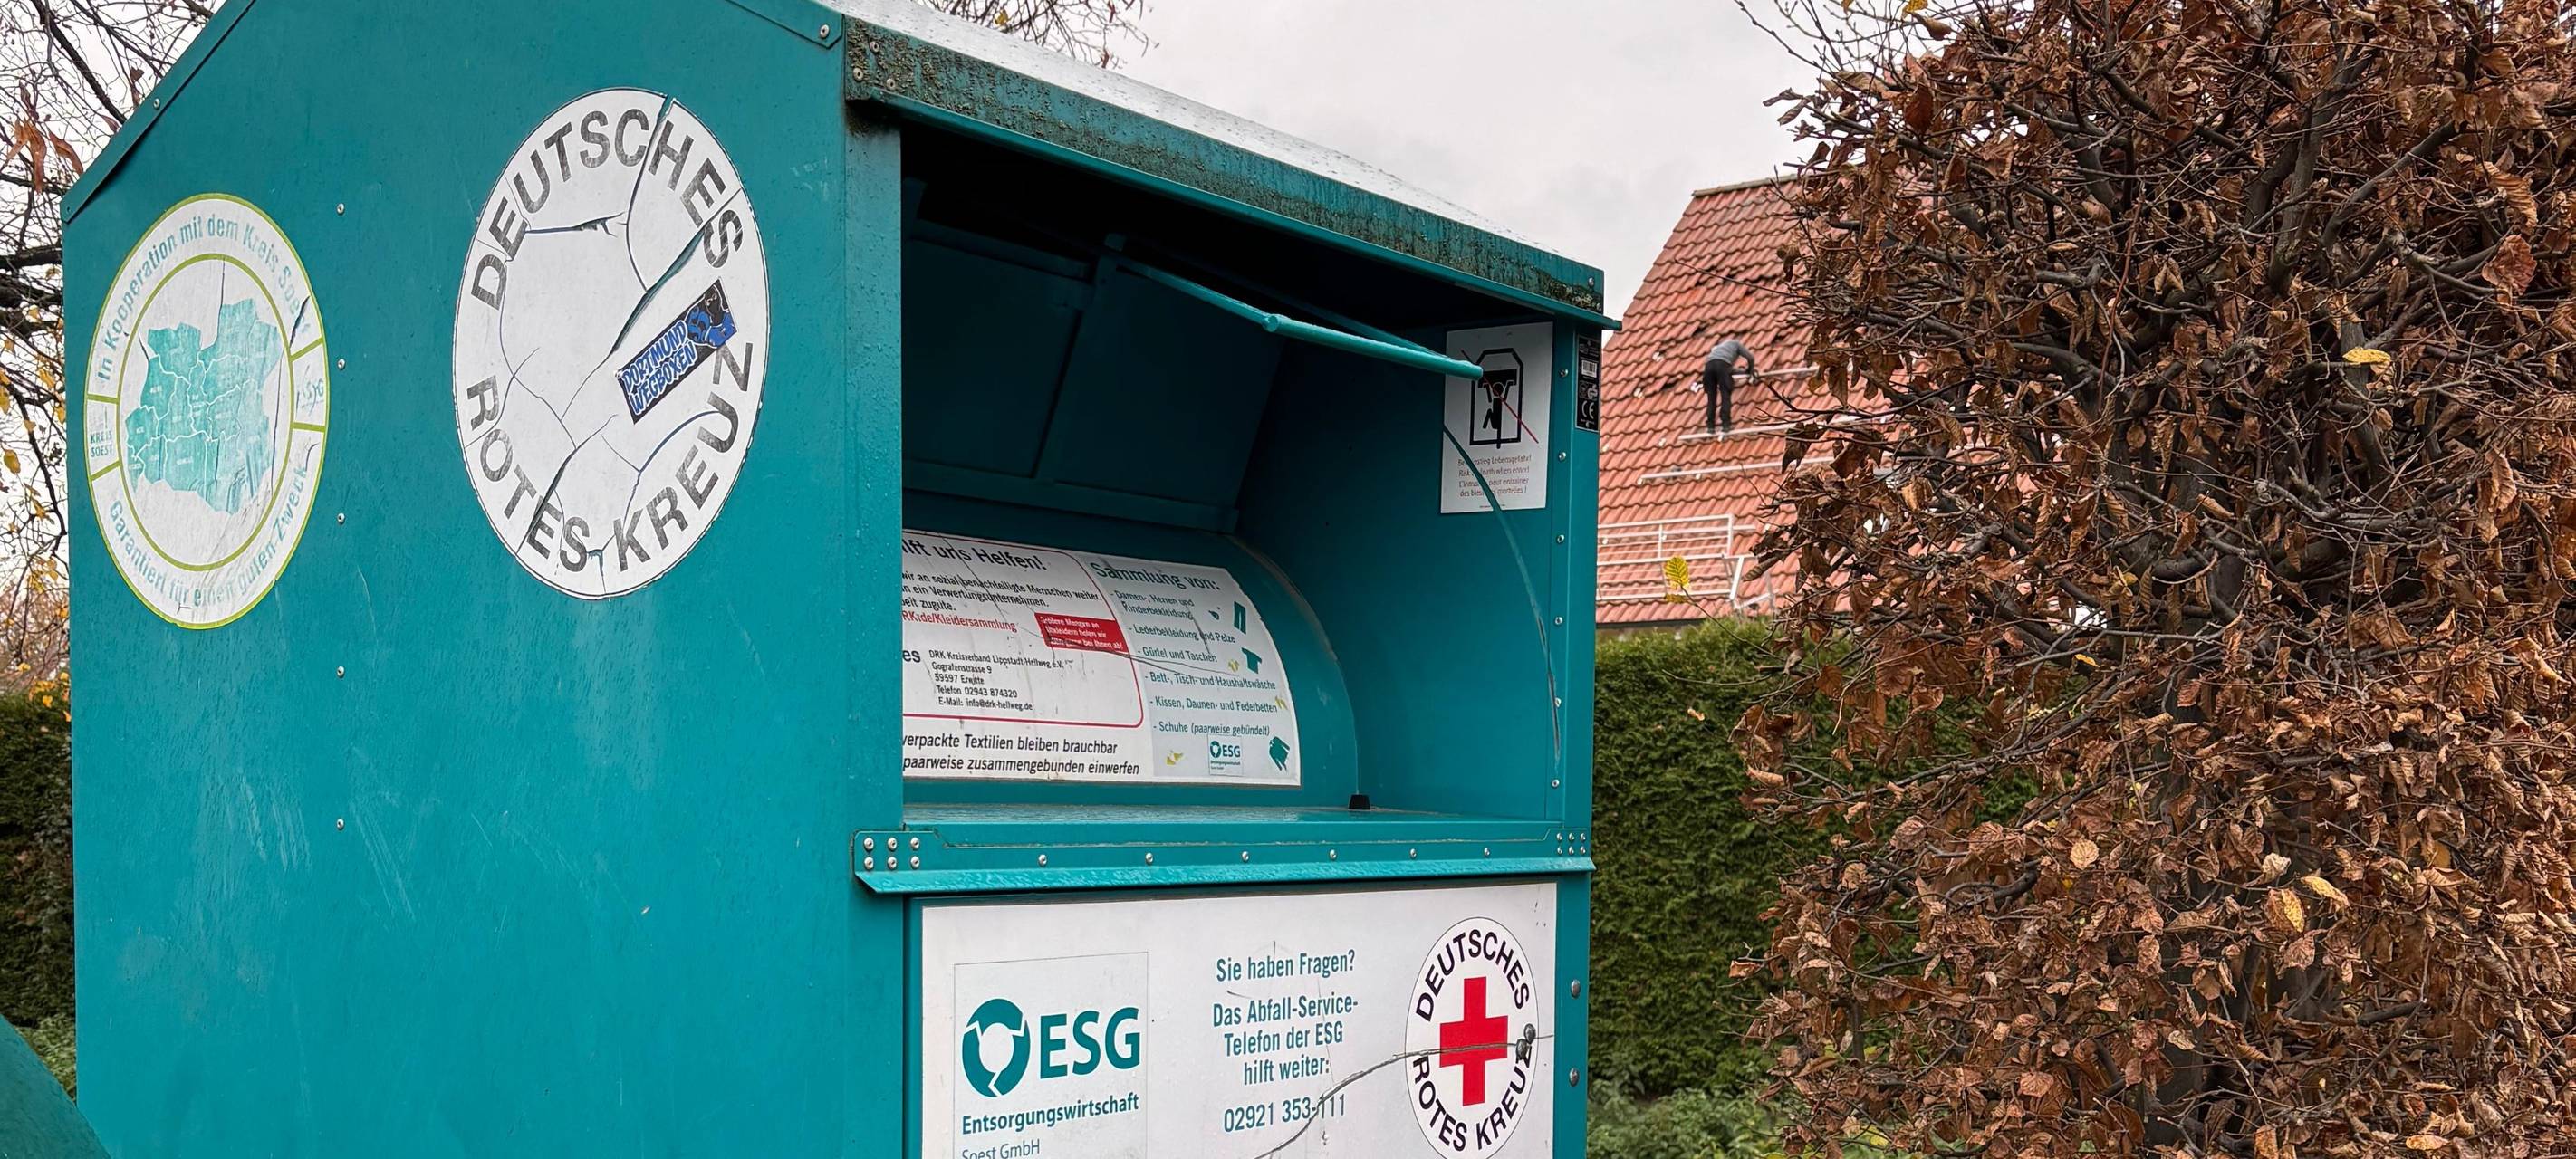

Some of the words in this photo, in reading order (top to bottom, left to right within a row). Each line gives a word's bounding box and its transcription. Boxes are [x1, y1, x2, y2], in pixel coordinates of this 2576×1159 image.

[471, 108, 744, 311] DEUTSCHES
[180, 215, 204, 244] mit
[207, 213, 238, 241] dem
[243, 223, 279, 273] Kreis
[103, 233, 178, 351] Kooperation
[278, 265, 312, 335] Soet
[97, 358, 113, 381] In
[622, 320, 688, 394] DORTMUND
[629, 341, 698, 415] WEGBOXEN
[91, 430, 112, 444] KREIS
[91, 444, 112, 458] SOEST
[466, 374, 591, 573] ROTES
[612, 340, 754, 572] KREUZ
[110, 500, 167, 593] Garantiert
[169, 576, 189, 605] für
[237, 541, 277, 596] guten
[273, 466, 308, 542] Zweck
[933, 545, 972, 561] uns
[971, 547, 1047, 570] Helfen!
[917, 573, 930, 583] an
[931, 574, 959, 586] sozial
[1026, 583, 1072, 599] Menschen
[1090, 562, 1187, 589] Sammlung
[1184, 576, 1221, 590] von:
[913, 584, 929, 595] ein
[920, 599, 957, 612] zugute.
[1178, 597, 1196, 608] und
[1132, 623, 1200, 641] Lederbekleidung
[1216, 632, 1236, 644] Pelze
[928, 649, 946, 659] DRK
[947, 650, 991, 663] Kreisverband
[992, 655, 1051, 669] Lippstadt-Hellweg
[1142, 646, 1168, 659] Gürtel
[1170, 649, 1185, 660] und
[1185, 650, 1217, 663] Taschen
[935, 673, 958, 684] 59597
[986, 665, 992, 674] 9
[1149, 671, 1174, 685] Bett-,
[1174, 673, 1198, 685] Tisch-
[1198, 676, 1215, 686] und
[1216, 676, 1276, 690] Haushaltswäsche
[937, 685, 962, 695] Telefon
[964, 686, 988, 696] 02943
[990, 688, 1018, 698] 874320
[938, 696, 964, 707] E-Mail:
[966, 698, 1033, 711] info@drk-hellweg.de
[1155, 695, 1185, 710] Kissen,
[1186, 697, 1218, 710] Daunen-
[1219, 700, 1235, 711] und
[1235, 700, 1278, 714] Federbetten
[1158, 721, 1188, 733] Schuhe
[1191, 723, 1231, 735] (paarweise
[1232, 724, 1271, 738] gebündelt)
[965, 734, 1014, 751] Textilien
[1017, 736, 1059, 752] bleiben
[1062, 738, 1118, 755] brauchbar
[1222, 743, 1241, 759] ESG
[903, 755, 964, 771] paarweise
[967, 758, 1085, 775] zusammengebunden
[1088, 760, 1140, 776] einwerfen
[1216, 957, 1241, 982] Sie
[1247, 954, 1293, 980] haben
[1299, 949, 1355, 979] Fragen?
[1416, 929, 1530, 1021] DEUTSCHES
[1213, 1002, 1241, 1027] Das
[1246, 991, 1359, 1023] Abfall-Service-
[1040, 1006, 1140, 1079] ESG
[1224, 1029, 1280, 1057] Telefon
[1285, 1026, 1311, 1049] der
[1315, 1020, 1343, 1046] ESG
[1244, 1058, 1274, 1086] hilft
[1279, 1054, 1330, 1080] weiter:
[962, 1091, 1139, 1135] Entsorgungswirtschaft
[1224, 1101, 1274, 1132] 02921
[1282, 1093, 1345, 1123] 353-111
[1413, 1055, 1467, 1152] ROTES
[1000, 1138, 1041, 1159] GmbH
